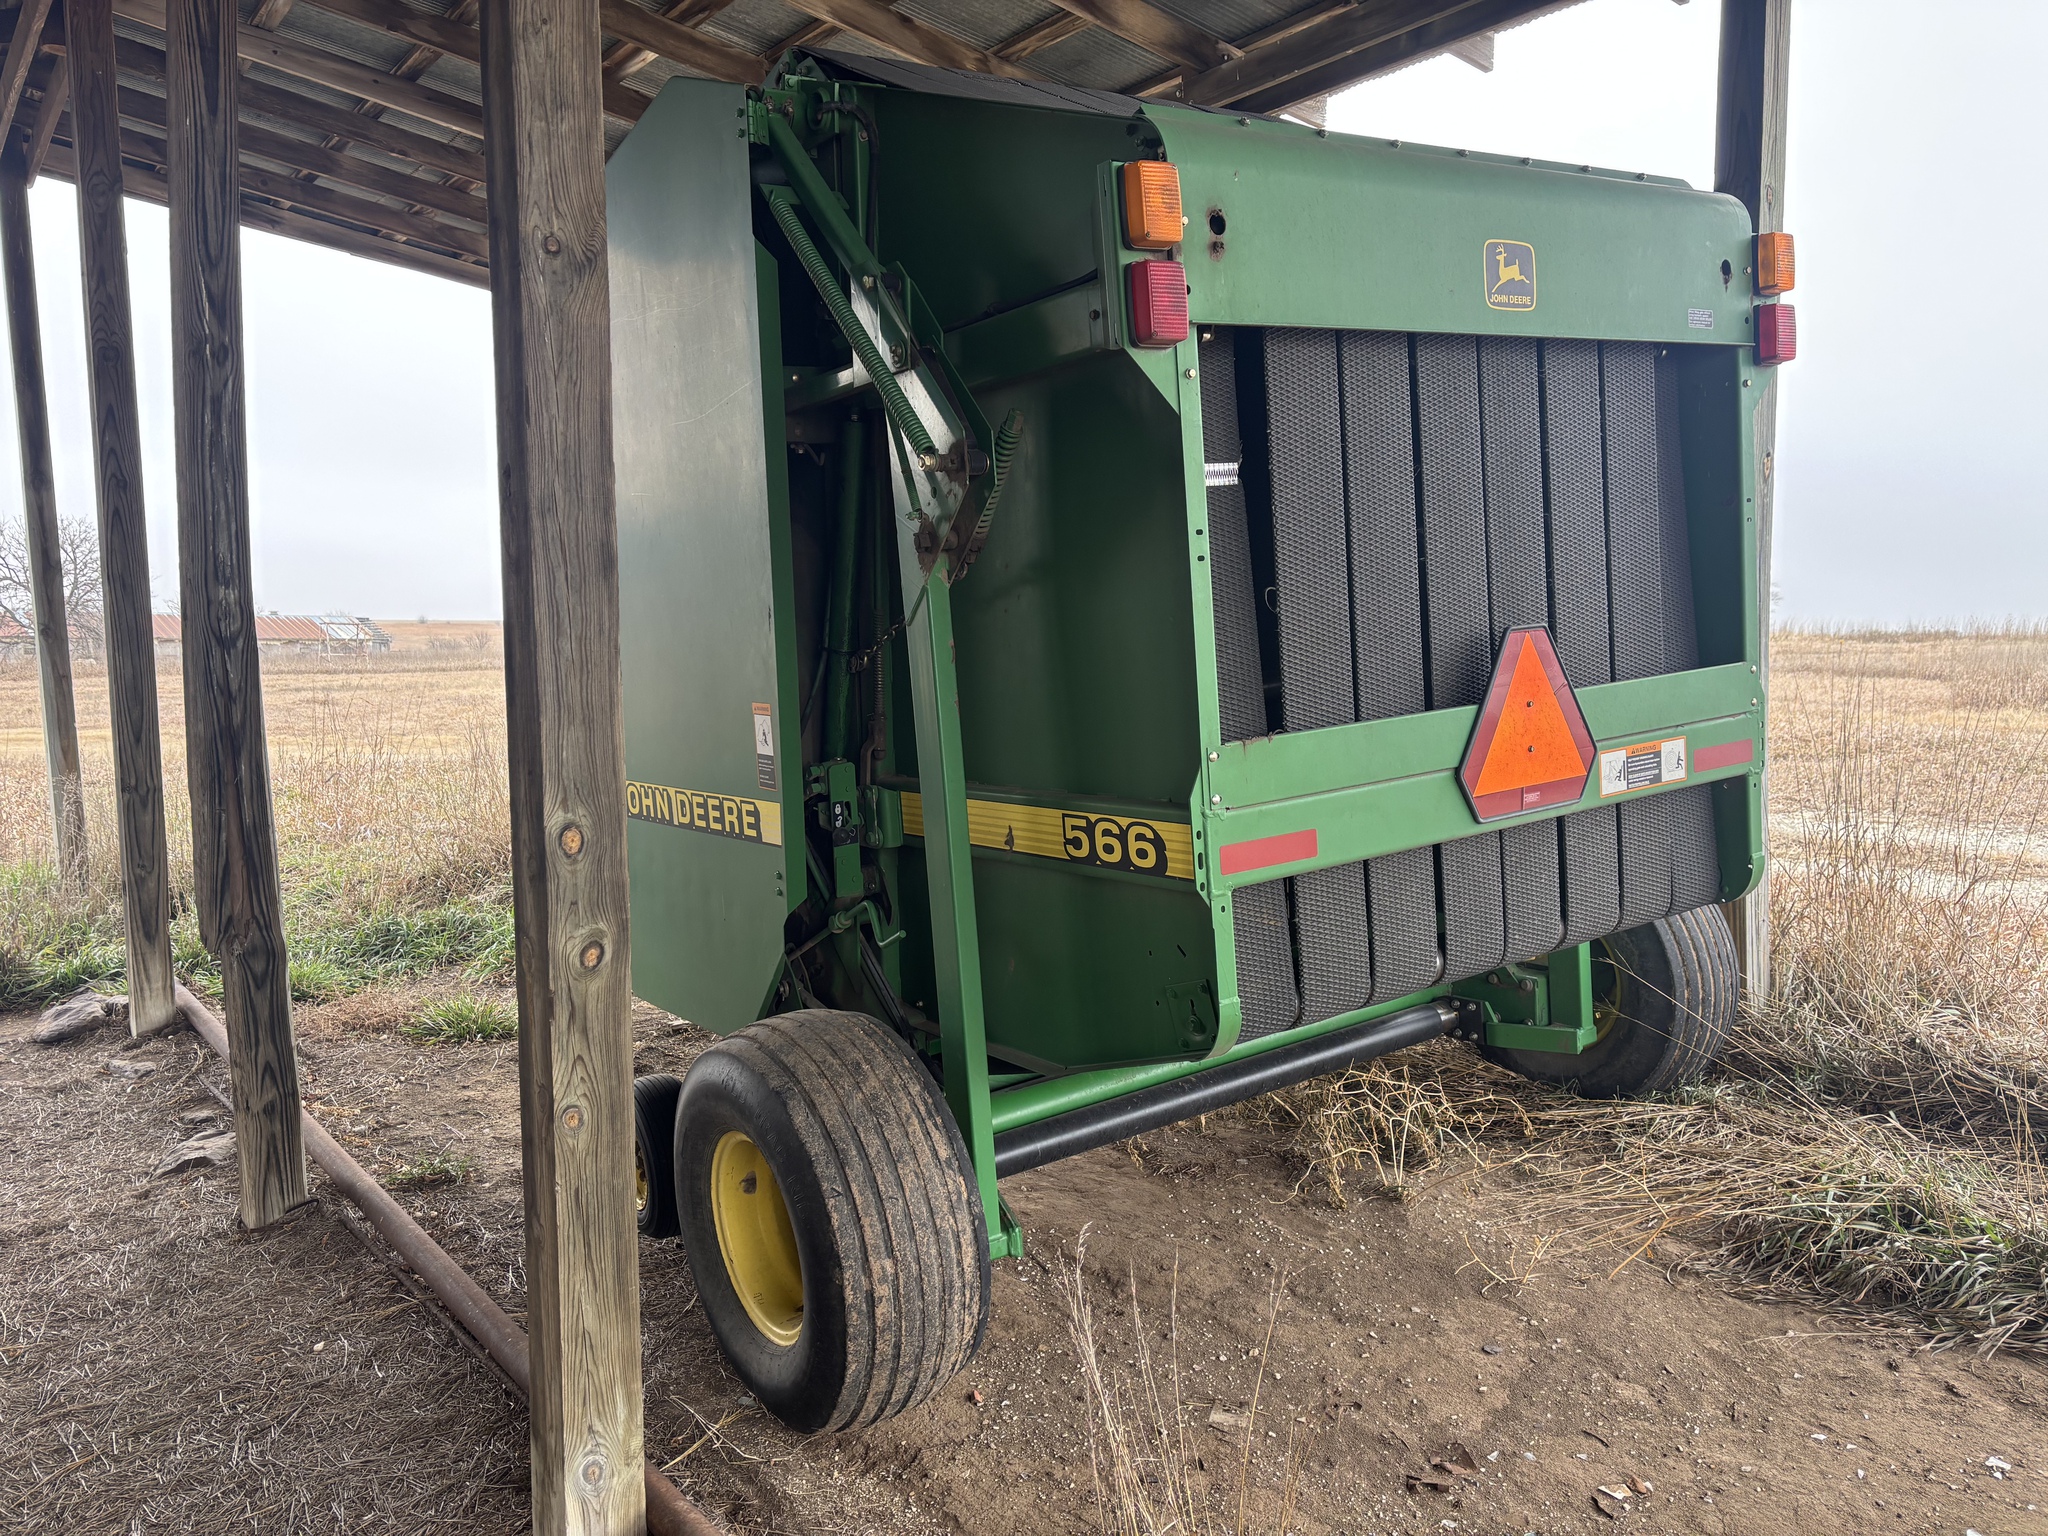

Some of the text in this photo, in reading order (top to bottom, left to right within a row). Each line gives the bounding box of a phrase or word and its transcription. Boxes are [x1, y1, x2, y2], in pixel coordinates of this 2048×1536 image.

[1490, 294, 1532, 305] JOHN DEERE
[626, 784, 758, 838] OHN DEERE
[1063, 815, 1158, 869] 566
